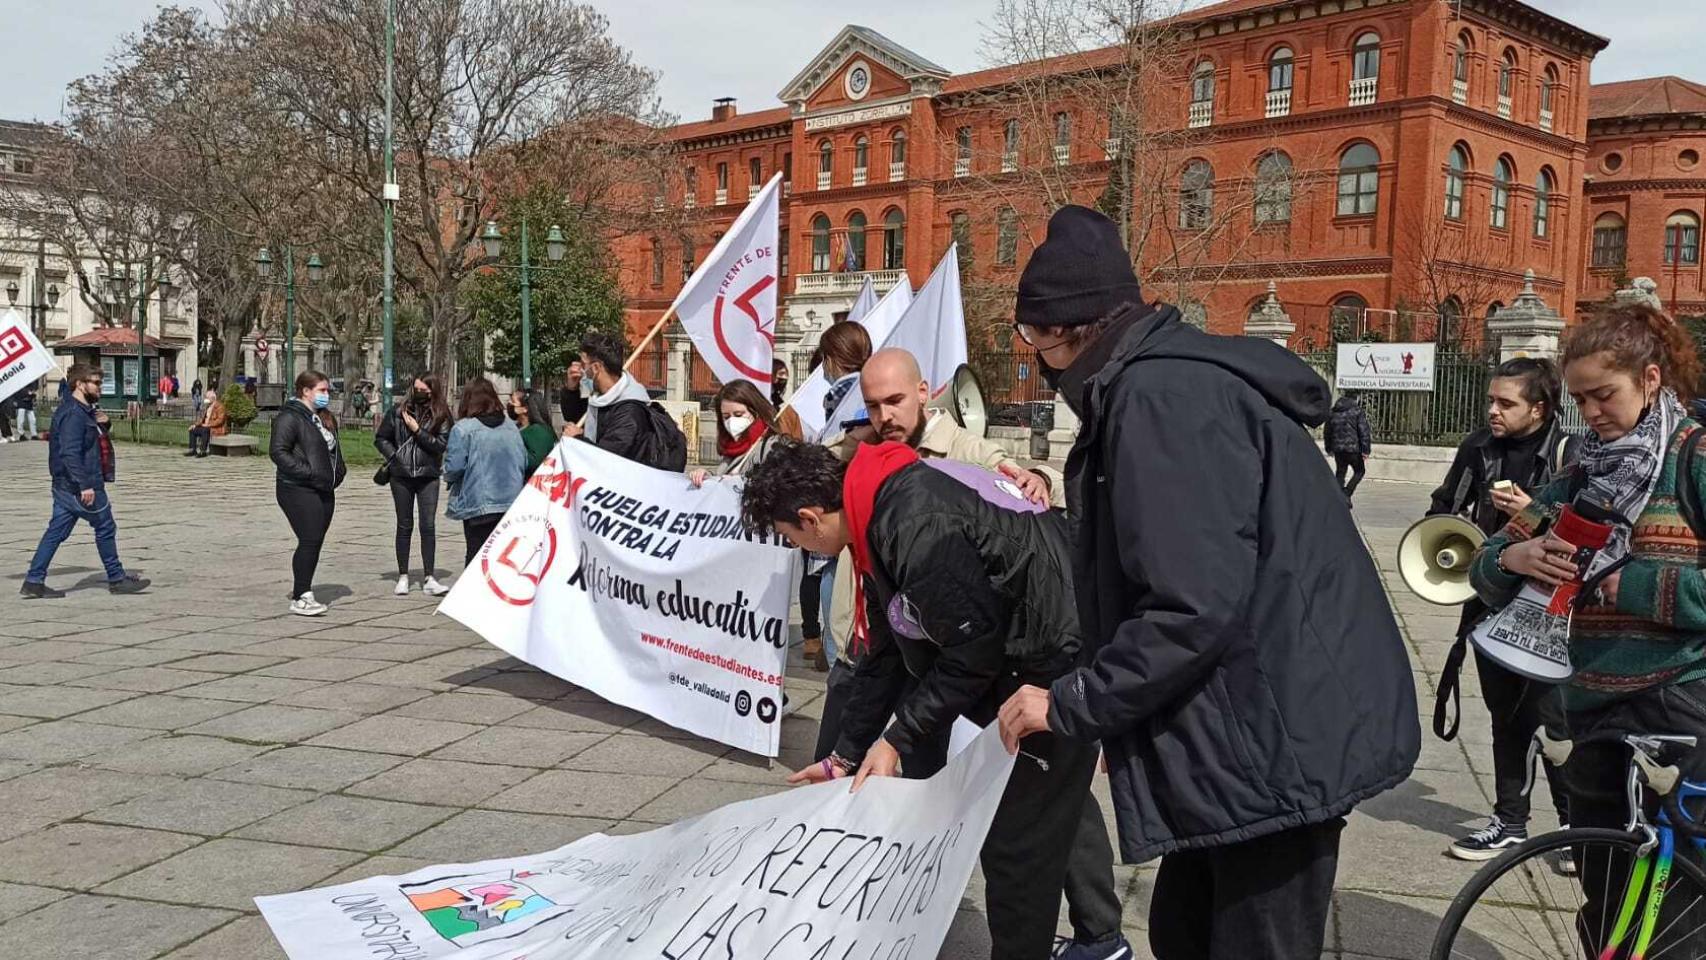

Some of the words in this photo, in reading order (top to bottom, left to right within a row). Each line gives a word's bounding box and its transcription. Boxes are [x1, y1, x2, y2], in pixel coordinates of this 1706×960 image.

[719, 253, 753, 297] FRENTE
[756, 247, 773, 259] DE
[579, 505, 655, 554] CONTRA
[649, 535, 682, 561] LA
[584, 486, 671, 531] HUELGA
[656, 579, 788, 649] educativa
[640, 631, 784, 687] www.frentedeestudiantes.es
[1520, 637, 1532, 648] TU
[668, 671, 731, 704] @fde_valladolid
[741, 822, 963, 925] REFORMAS
[661, 894, 767, 960] LAS
